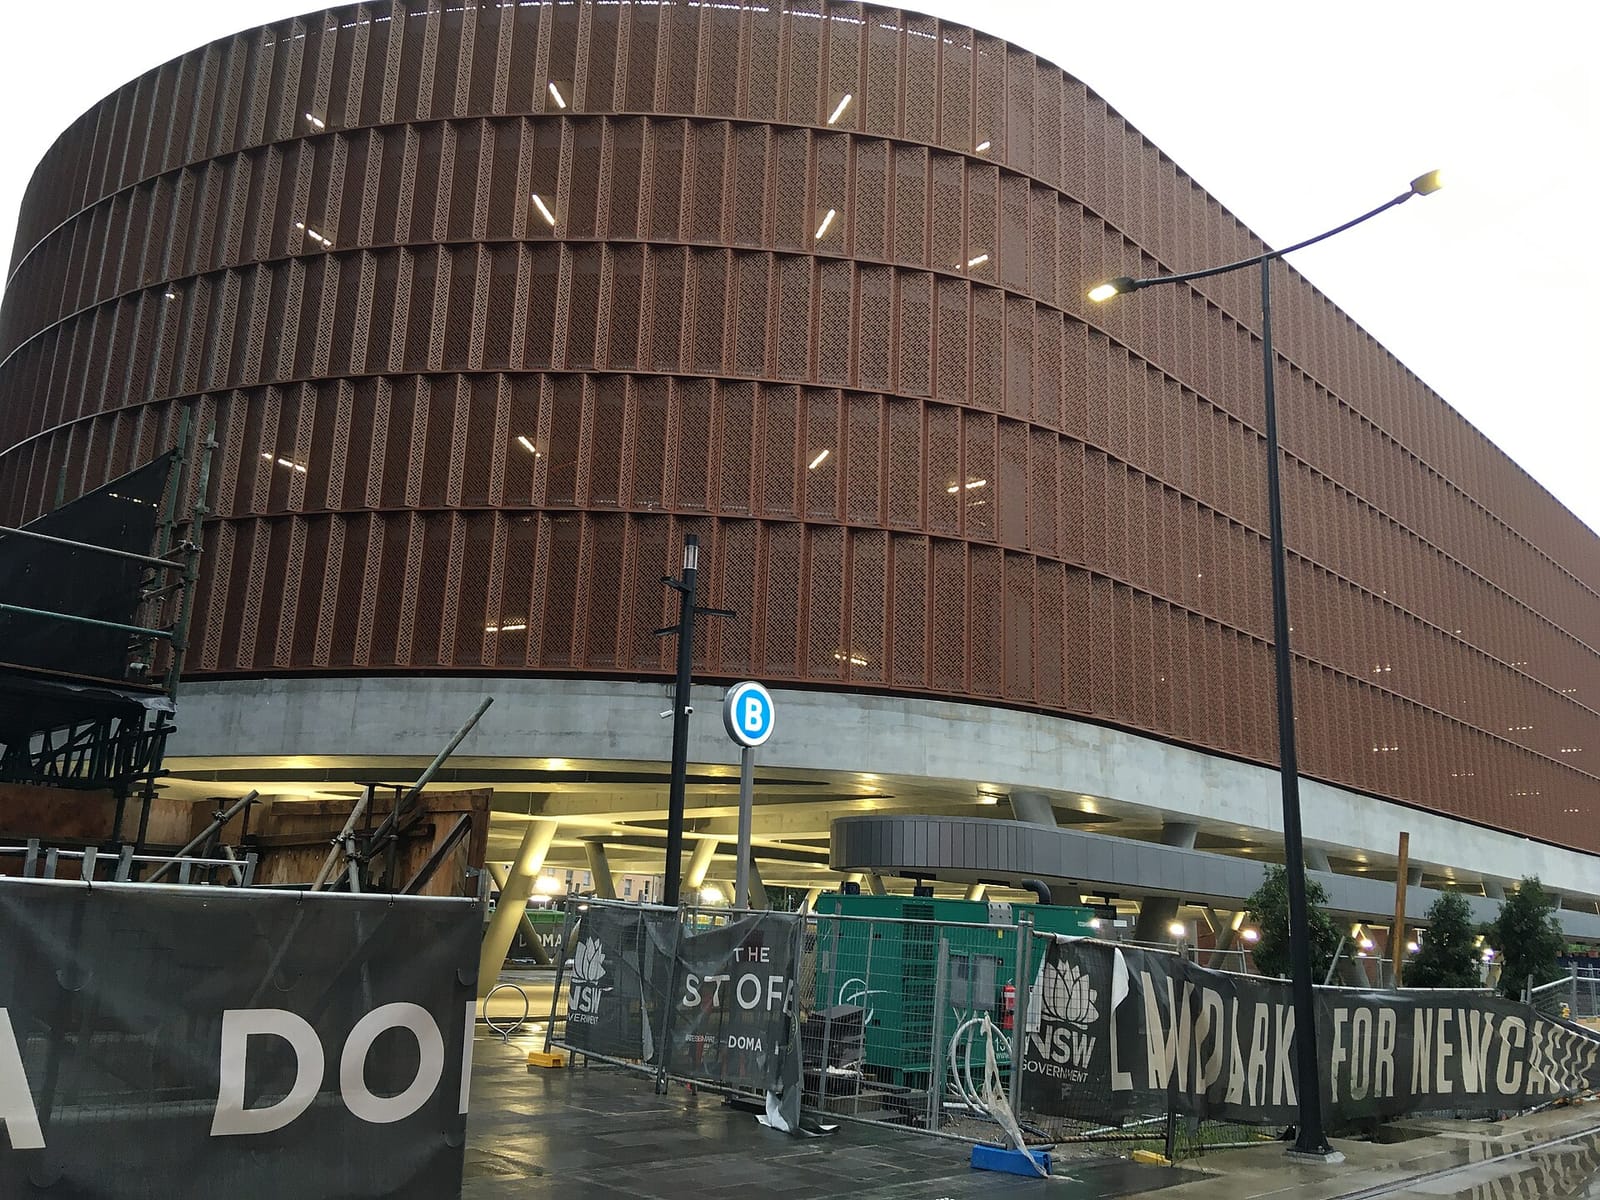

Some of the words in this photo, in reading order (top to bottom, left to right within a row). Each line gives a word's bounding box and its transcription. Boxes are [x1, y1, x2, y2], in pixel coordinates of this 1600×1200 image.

[744, 696, 763, 732] B
[733, 946, 770, 962] THE
[728, 1034, 763, 1052] DOMA
[1024, 1024, 1097, 1069] NSW
[1331, 1007, 1397, 1103] FOR
[210, 1002, 477, 1137] DO
